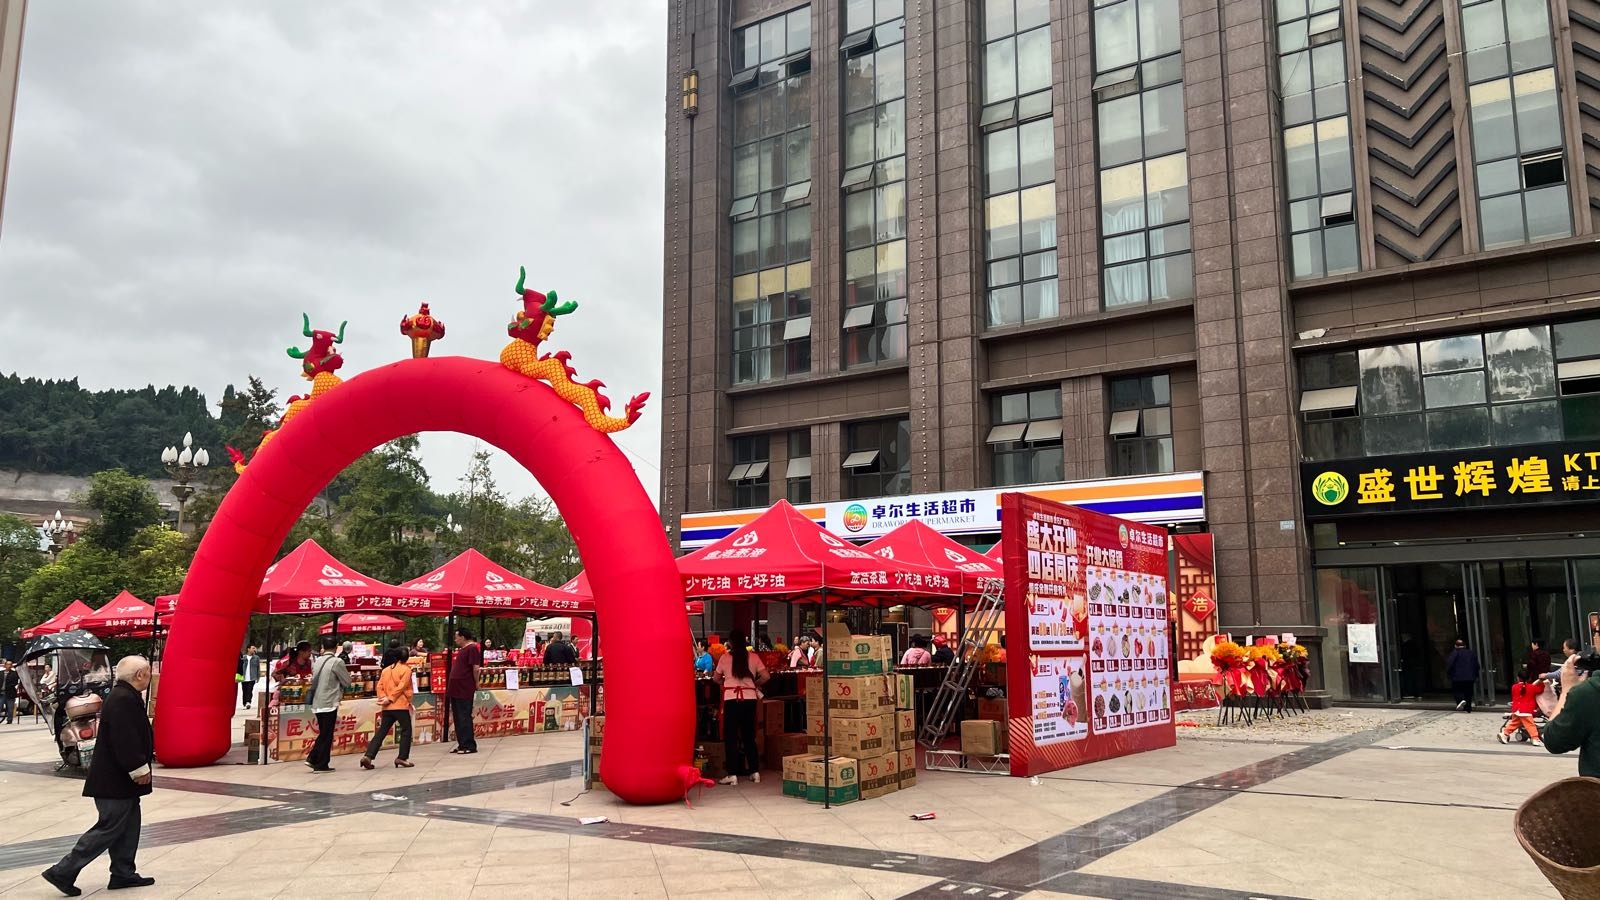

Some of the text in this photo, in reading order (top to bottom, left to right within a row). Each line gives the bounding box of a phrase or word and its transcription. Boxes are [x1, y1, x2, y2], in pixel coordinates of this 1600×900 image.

[1564, 452, 1600, 472] KT
[1356, 456, 1553, 504] 盛世辉煌
[1561, 475, 1600, 491] 请上
[872, 498, 976, 519] 卓尔生活超市
[1027, 519, 1077, 555] 盛大开业
[1130, 528, 1164, 547] 卓尔生活超市
[1028, 550, 1079, 583] 四店同庆
[685, 573, 786, 591] 少吃油 吃好油
[894, 571, 922, 586] 少吃油
[925, 574, 950, 588] 吃好油
[299, 596, 430, 609] 金浩茶油 少吃油 吃好油
[520, 597, 548, 607] 少吃油
[287, 715, 357, 737] 匠心浩
